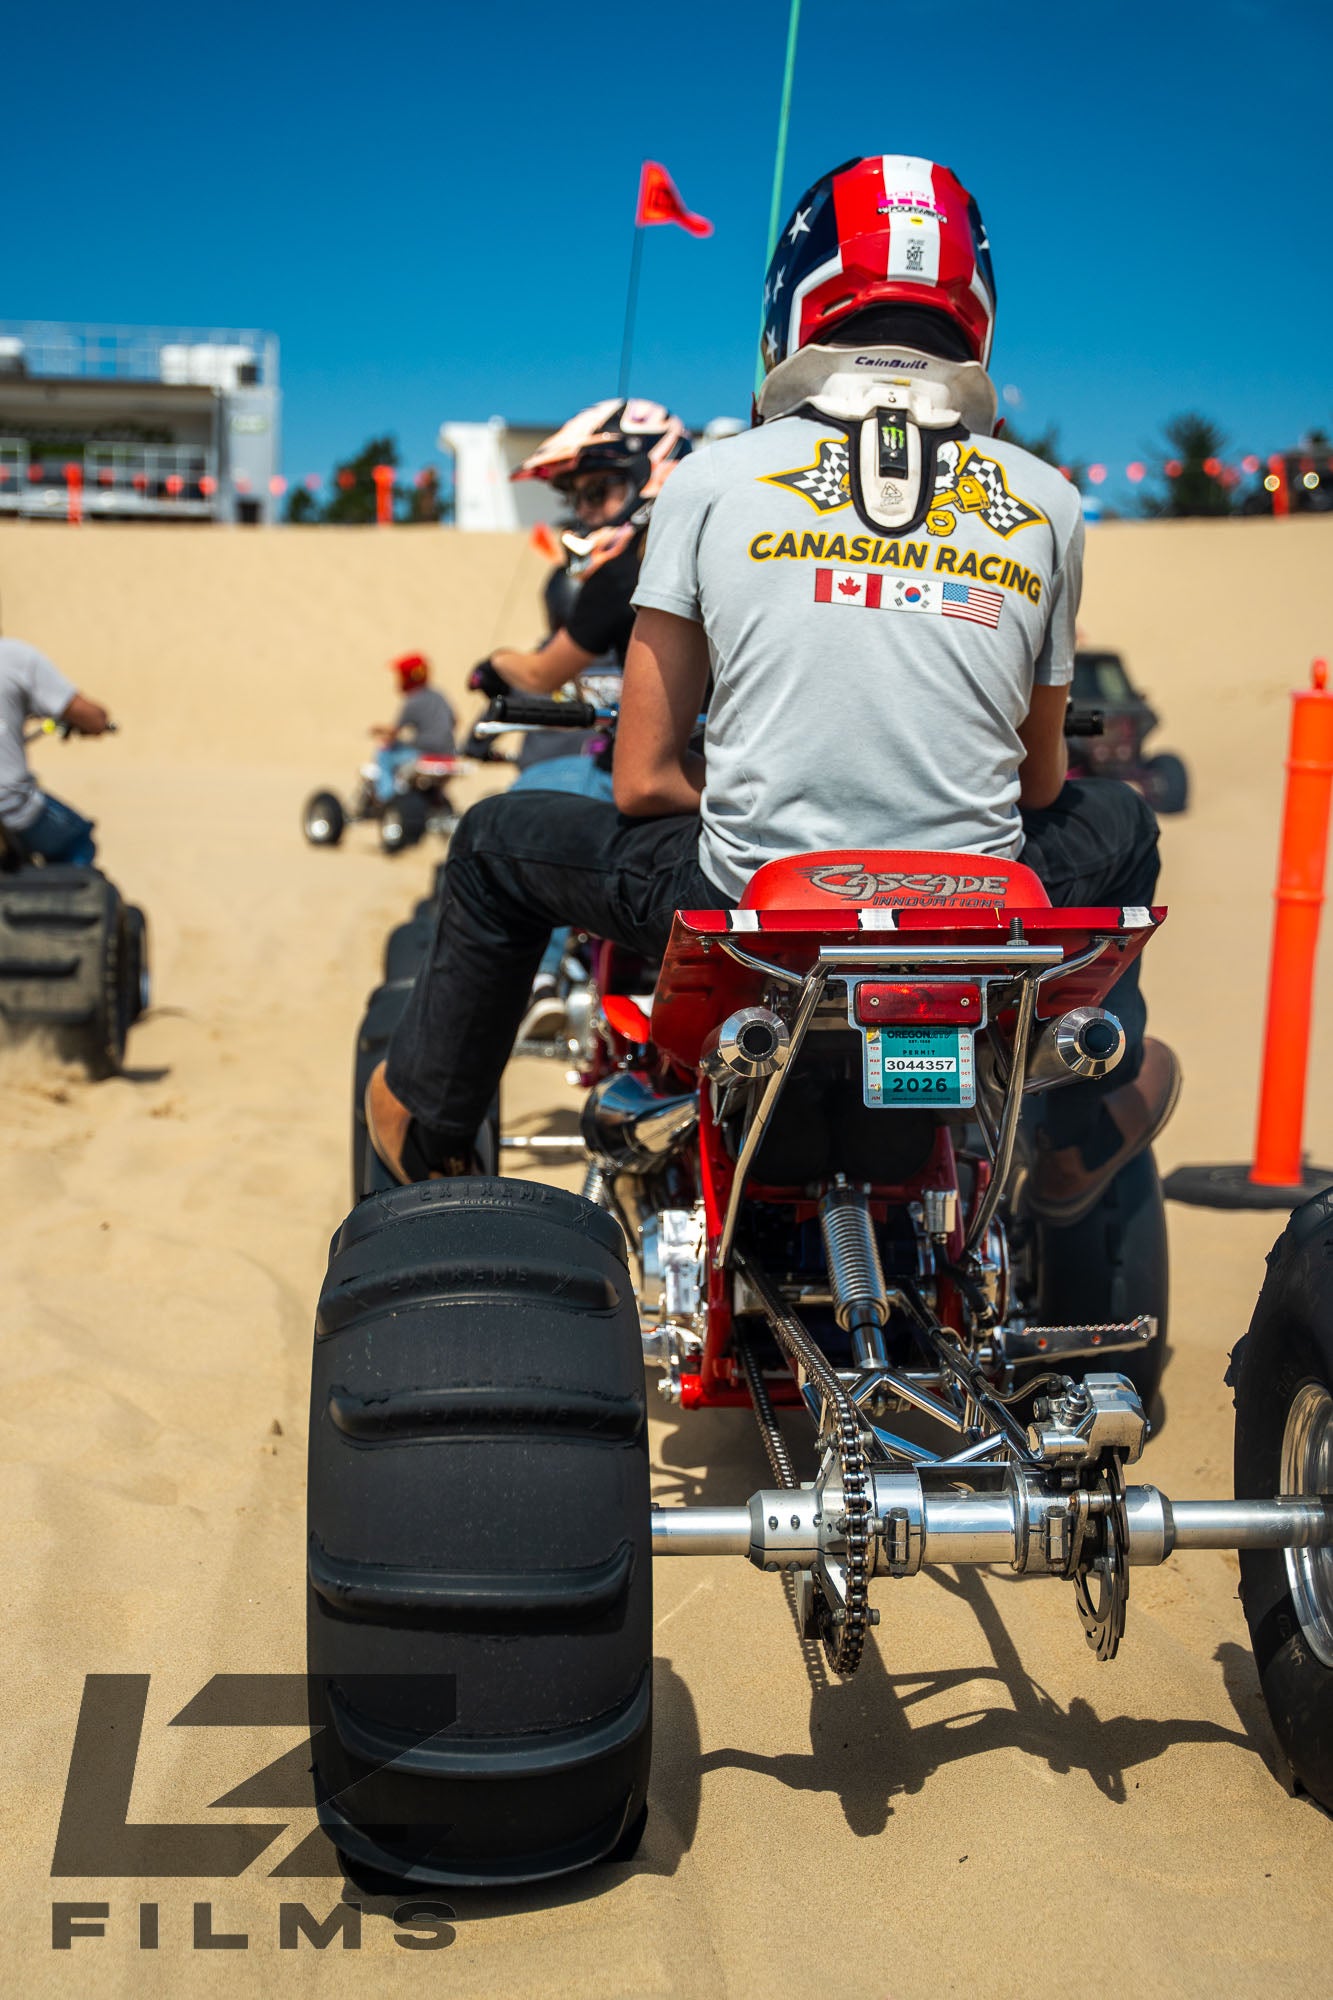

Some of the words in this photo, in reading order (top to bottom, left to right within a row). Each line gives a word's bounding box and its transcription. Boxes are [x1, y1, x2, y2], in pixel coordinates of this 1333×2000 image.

[855, 356, 929, 370] CainBuilt
[750, 530, 929, 571] CANASIAN
[934, 545, 1043, 606] RACING
[797, 863, 1009, 901] CASCADE
[873, 895, 1006, 909] INNOVATIONS
[887, 1060, 954, 1071] 3044357
[893, 1077, 948, 1093] 2026
